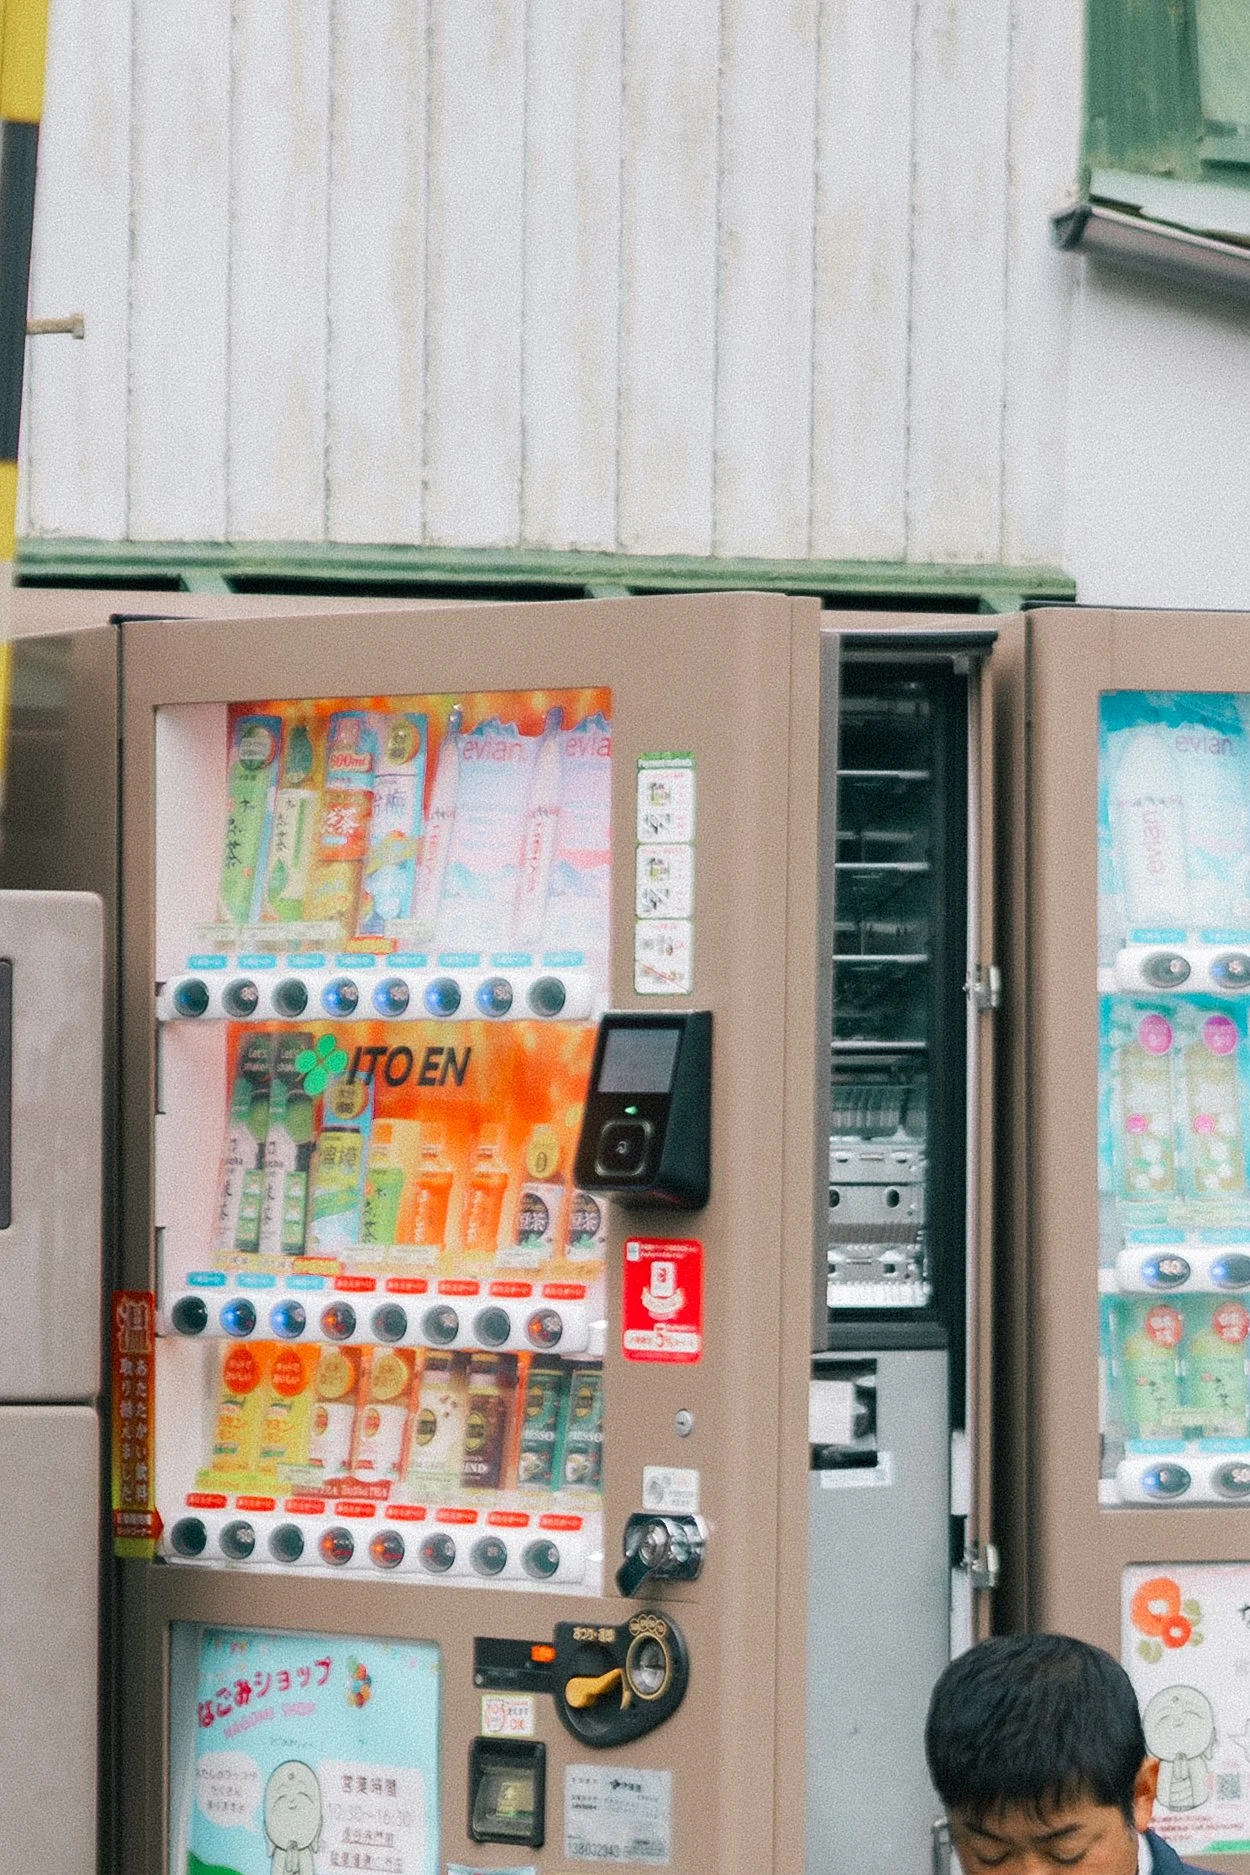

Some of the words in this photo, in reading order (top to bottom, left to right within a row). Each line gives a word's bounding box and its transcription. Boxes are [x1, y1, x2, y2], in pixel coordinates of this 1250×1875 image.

[462, 736, 524, 762] evian
[1174, 733, 1233, 757] evian
[346, 1046, 413, 1087] ITO
[418, 1046, 472, 1087] EN
[196, 1656, 335, 1728] なごみショップ
